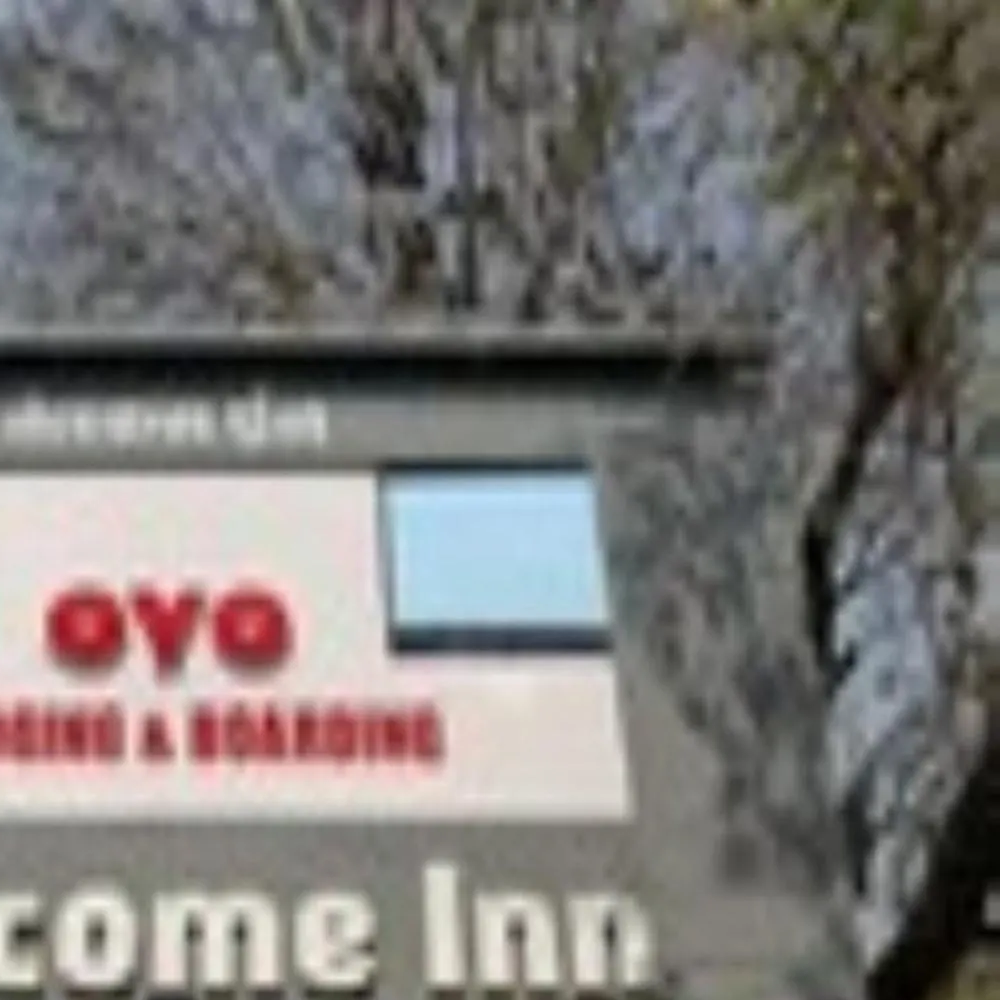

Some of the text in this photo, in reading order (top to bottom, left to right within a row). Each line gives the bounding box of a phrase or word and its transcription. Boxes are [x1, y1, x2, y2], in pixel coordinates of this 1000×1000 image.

[46, 585, 294, 676] OYO
[190, 704, 445, 766] BOARDING
[422, 862, 654, 990] Inn
